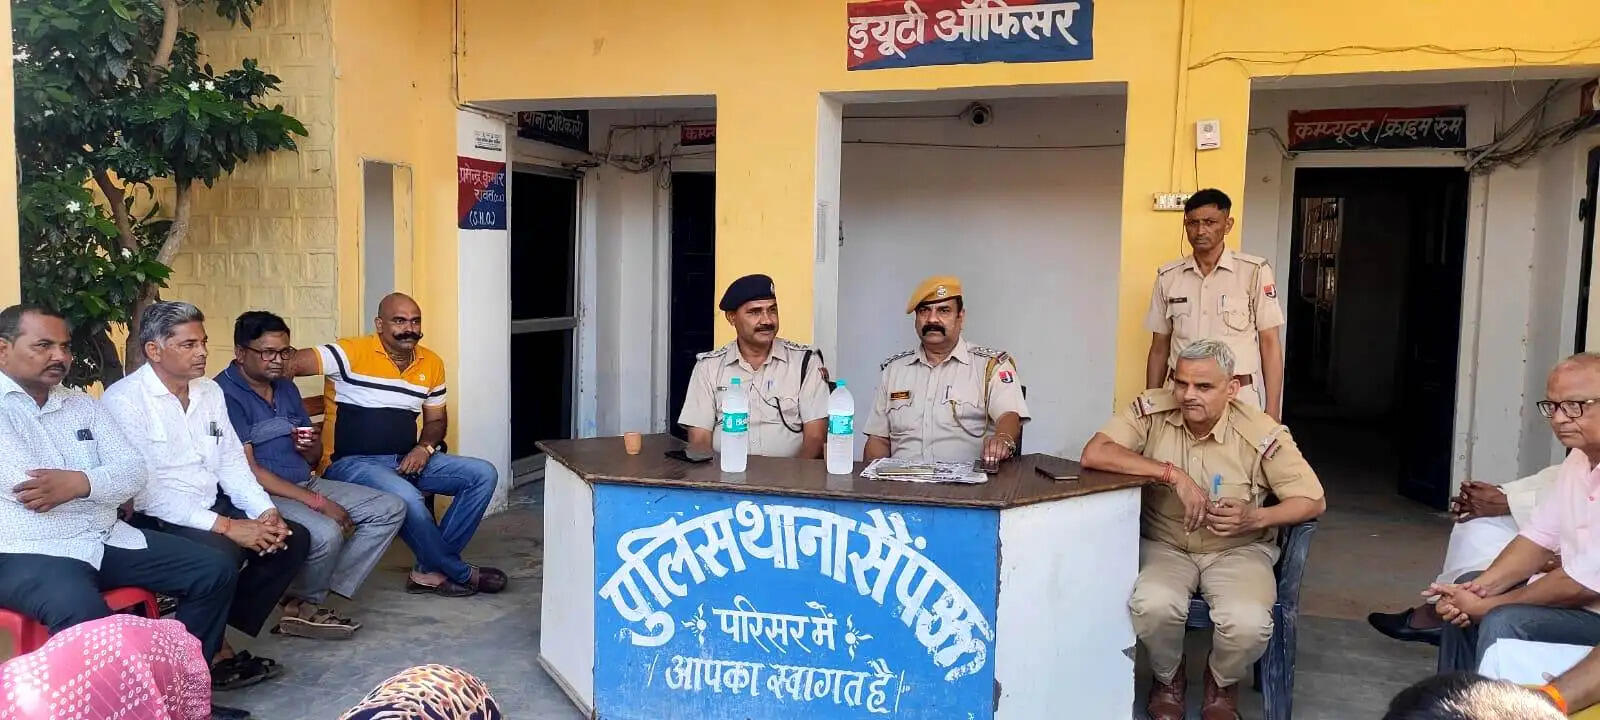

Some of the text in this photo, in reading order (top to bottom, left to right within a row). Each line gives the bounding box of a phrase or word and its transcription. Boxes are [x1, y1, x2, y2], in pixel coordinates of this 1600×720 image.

[849, 0, 1081, 59] ड्यूटी ऑफिसर
[1433, 115, 1464, 142] रूम
[473, 188, 494, 203] रावत
[482, 170, 505, 188] कुमार
[598, 508, 747, 647] पुलिस
[735, 500, 857, 583] थाना
[712, 595, 839, 654] परिसर में
[664, 654, 898, 713] आपका स्वागत है
